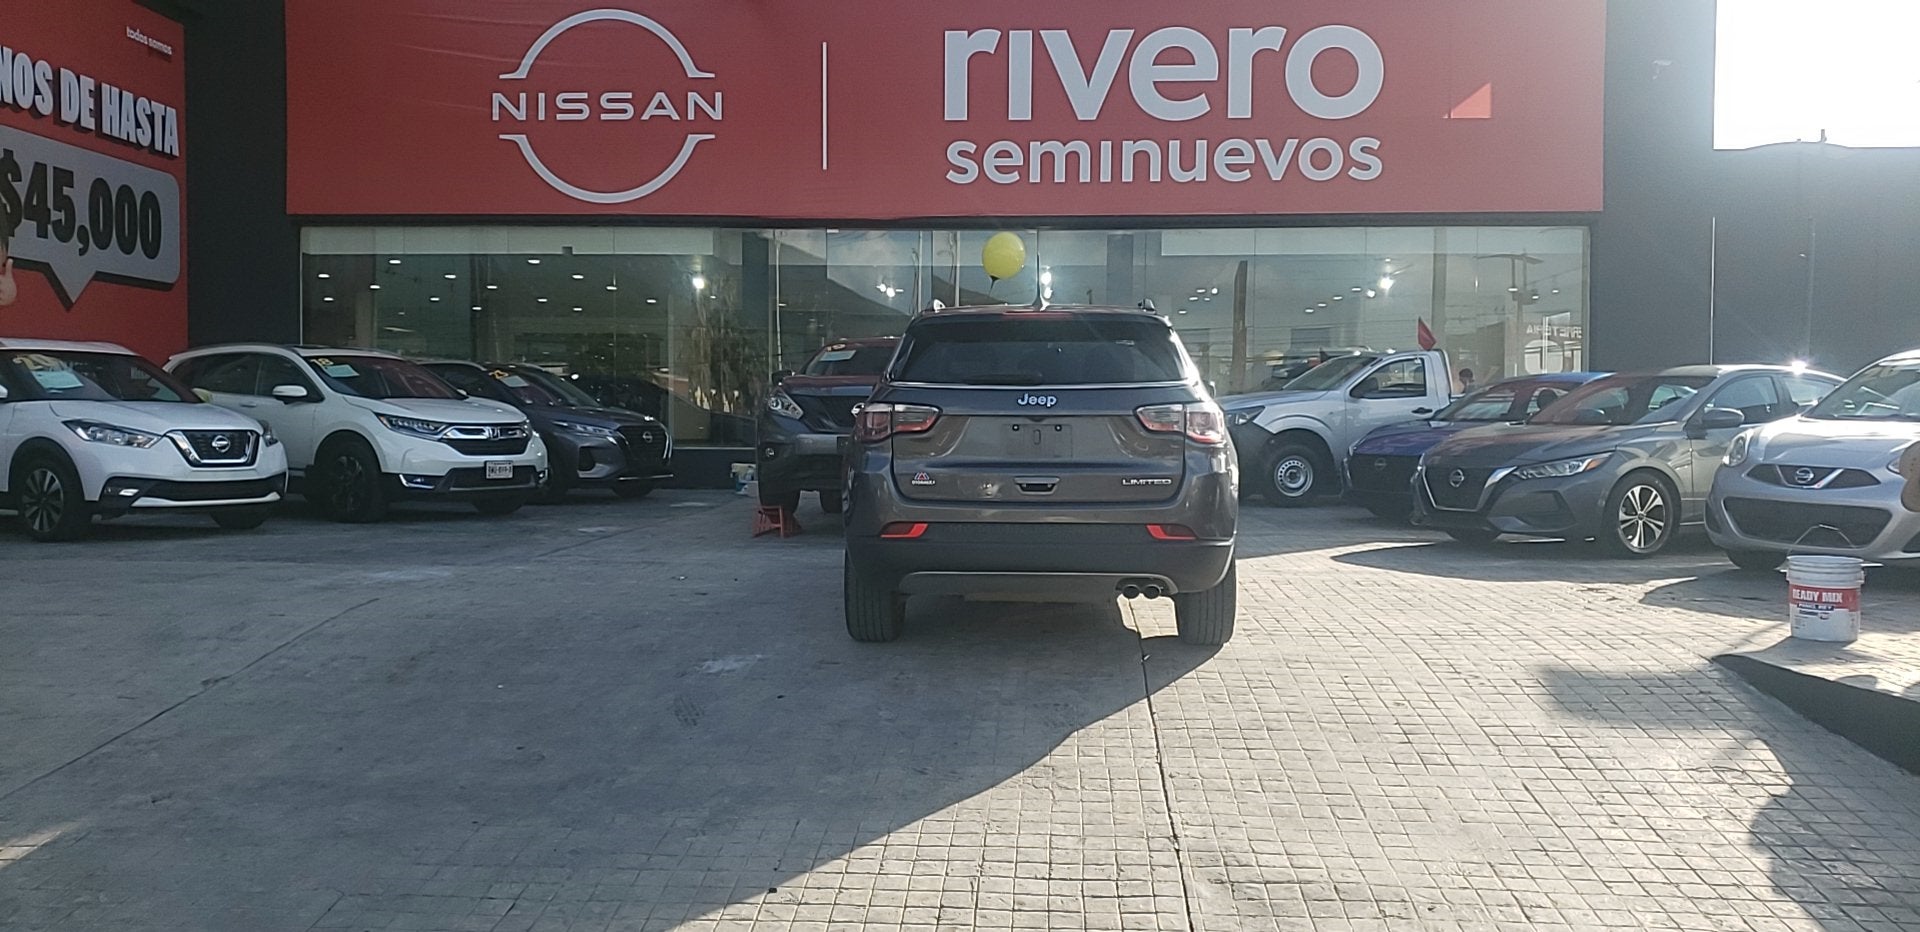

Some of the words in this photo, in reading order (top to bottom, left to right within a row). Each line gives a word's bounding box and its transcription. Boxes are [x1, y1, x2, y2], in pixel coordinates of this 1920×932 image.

[126, 26, 148, 45] todos
[944, 25, 1384, 120] rivero
[60, 67, 96, 130] DE
[100, 82, 180, 157] HASTA
[492, 92, 722, 121] NISSAN
[945, 137, 1384, 184] seminuevos
[0, 147, 162, 260] $45,000
[1017, 393, 1057, 408] Jeep
[1793, 589, 1819, 602] READY
[1822, 592, 1842, 603] MIX
